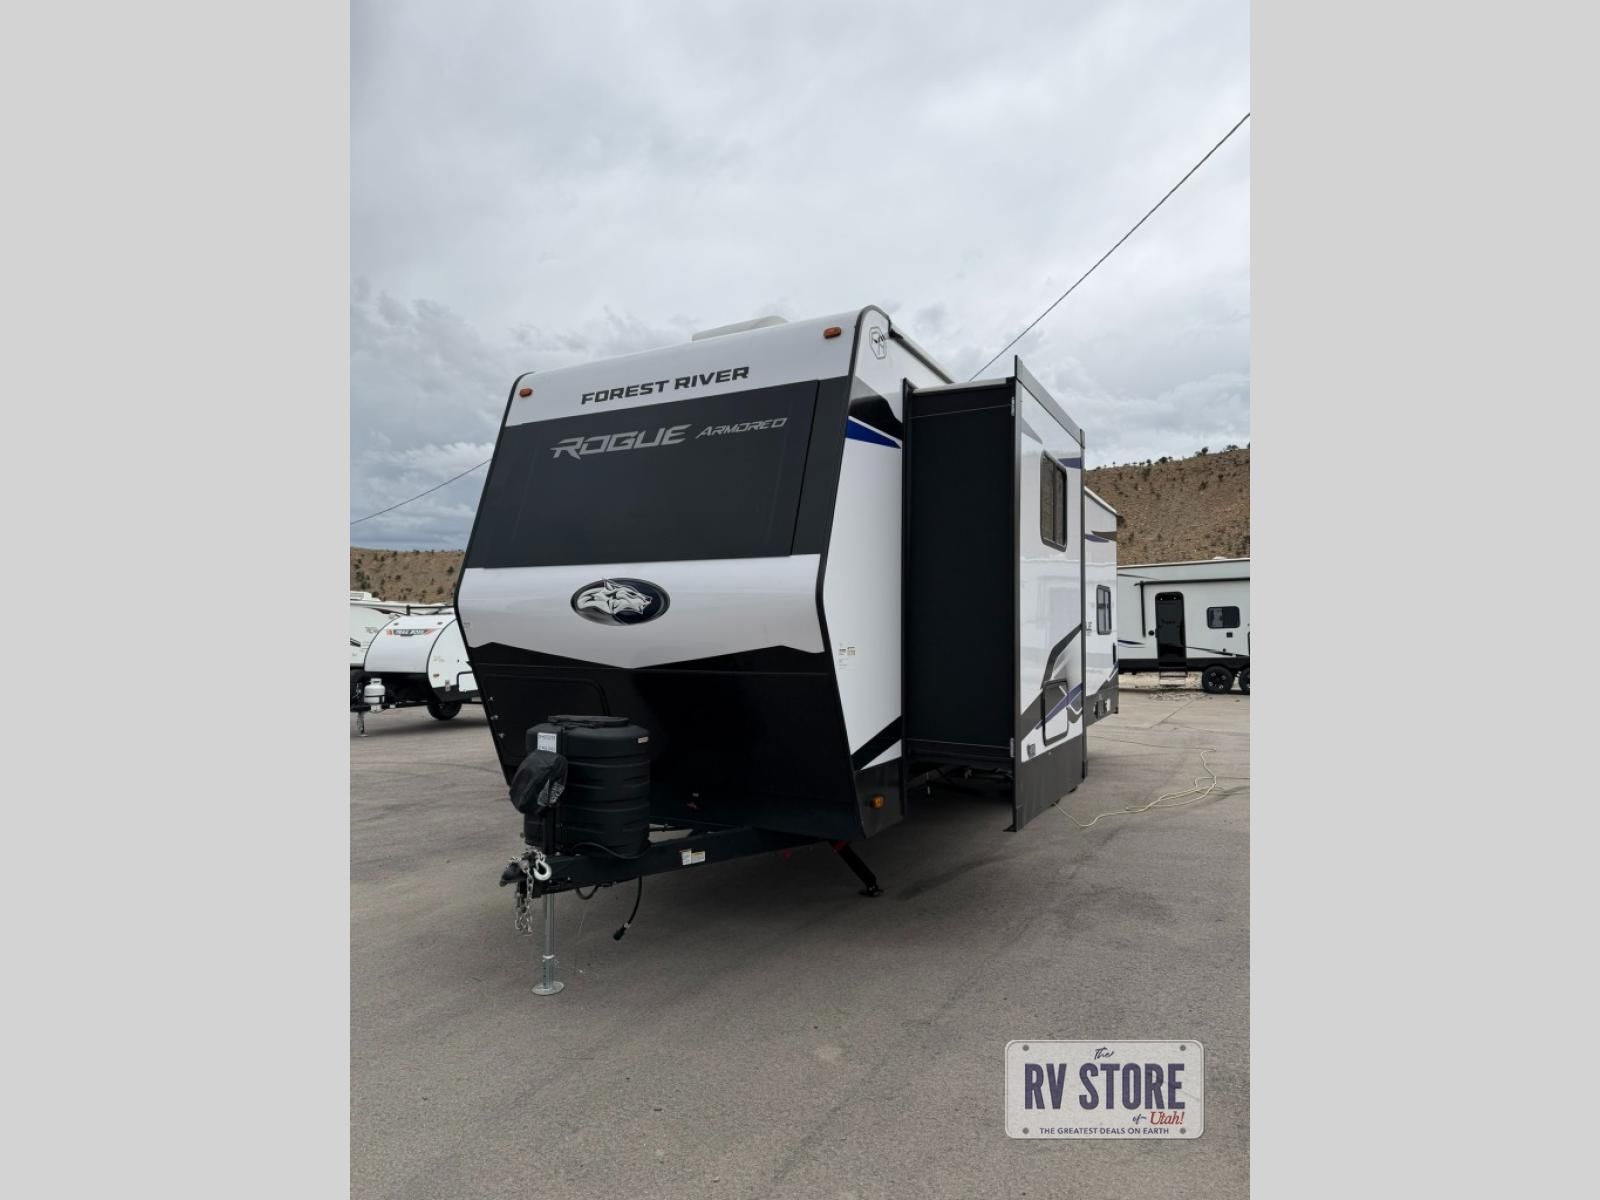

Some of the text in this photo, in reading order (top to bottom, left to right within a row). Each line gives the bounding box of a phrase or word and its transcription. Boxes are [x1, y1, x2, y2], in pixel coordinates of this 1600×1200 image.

[581, 366, 750, 405] FOREST RIVER
[550, 417, 788, 460] ROGUE ARMORED
